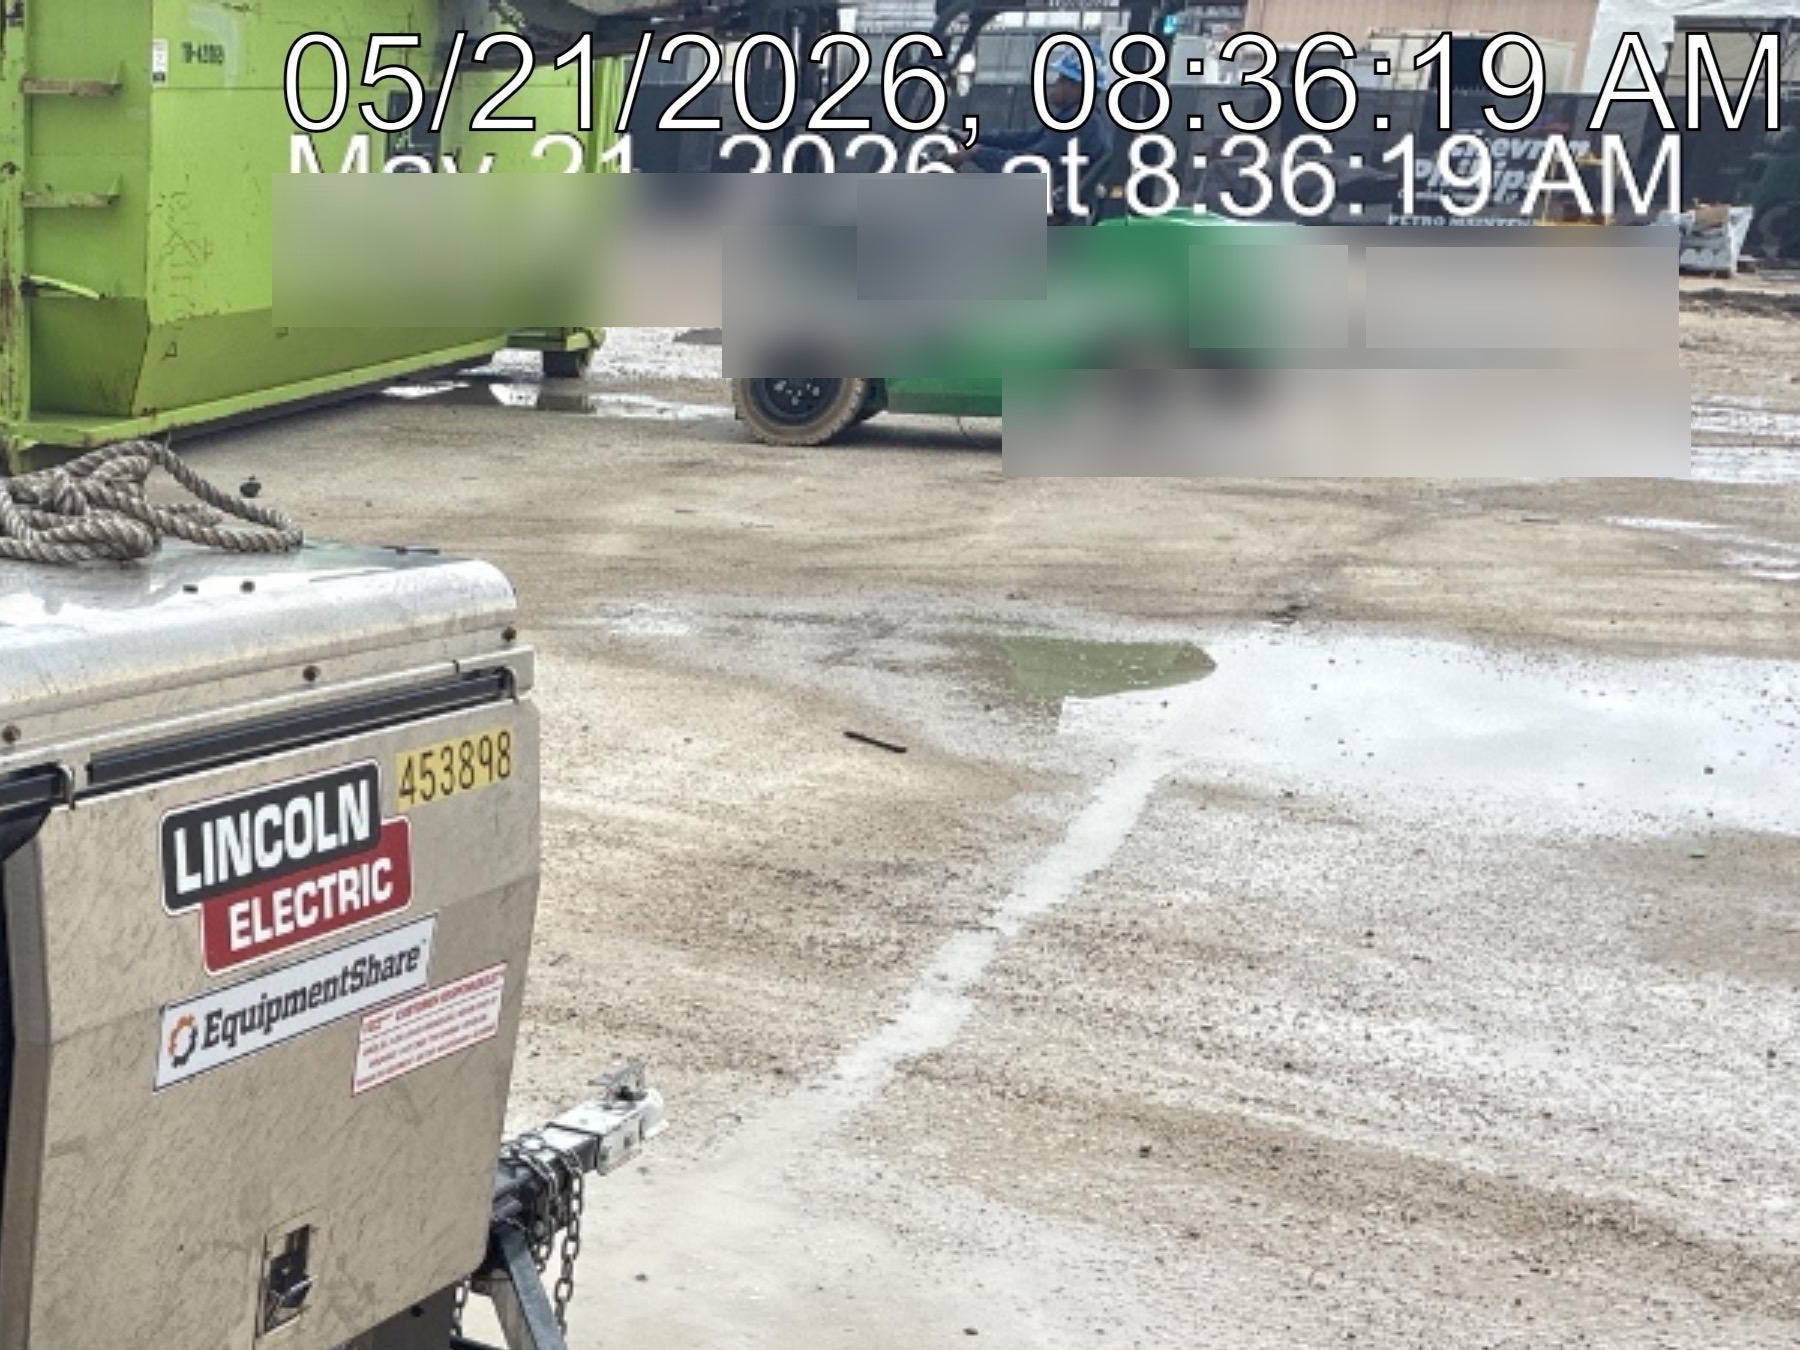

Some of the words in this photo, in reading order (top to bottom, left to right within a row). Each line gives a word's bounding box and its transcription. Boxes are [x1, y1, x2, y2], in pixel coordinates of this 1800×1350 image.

[399, 730, 512, 805] 453898
[172, 778, 371, 894] LINCOLN
[228, 856, 394, 953] ELECTRIC
[201, 943, 423, 1050] EquipmentShare
